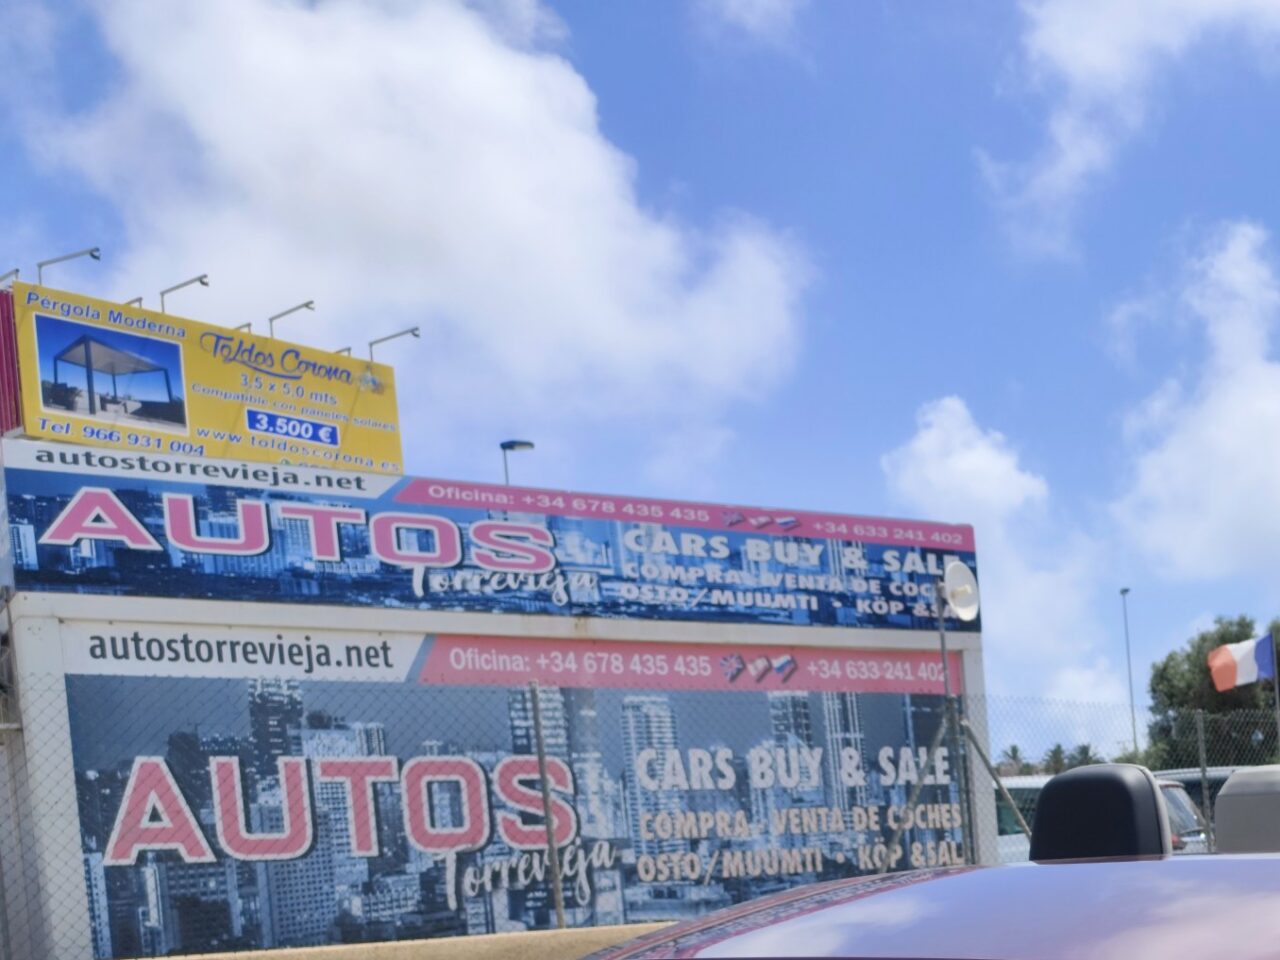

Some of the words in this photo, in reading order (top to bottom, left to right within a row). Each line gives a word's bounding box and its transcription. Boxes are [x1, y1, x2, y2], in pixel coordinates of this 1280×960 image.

[27, 292, 101, 320] Pérgola
[108, 309, 186, 337] Moderna
[200, 332, 275, 369] Toldos
[281, 349, 353, 384] Corona
[192, 383, 269, 406] Compatible
[272, 400, 297, 412] con
[352, 416, 396, 432] solares
[310, 390, 337, 405] mts
[83, 426, 121, 443] 966
[127, 433, 162, 449] 931
[169, 441, 205, 457] 004
[256, 413, 313, 439] 3.500
[318, 426, 333, 443] €
[36, 447, 367, 492] autostorrevieja.net
[428, 484, 515, 505] Oficina:
[522, 493, 566, 509] +34
[572, 498, 615, 514] 678
[622, 503, 664, 518] 435
[670, 507, 710, 523] 435
[38, 486, 556, 574] AUTOS
[623, 528, 730, 559] CARS
[746, 538, 824, 566] BUY
[842, 547, 868, 570] &
[813, 521, 848, 535] +34
[853, 525, 888, 538] 633
[893, 528, 925, 542] 241
[931, 531, 963, 545] 402
[624, 562, 743, 584] COMPRA
[768, 572, 844, 593] VENTA
[850, 578, 882, 595] DE
[857, 596, 904, 615] KÖP
[89, 630, 393, 674] autostorrevieja.net
[450, 648, 531, 672] Oficina:
[536, 651, 578, 673] +34
[583, 652, 624, 674] 678
[629, 654, 669, 675] 435
[674, 656, 712, 676] 435
[807, 659, 842, 679] +34
[845, 660, 880, 680] 633
[884, 661, 914, 681] 241
[918, 662, 947, 682] 402
[636, 747, 736, 790] CARS
[749, 746, 824, 789] BUY
[841, 746, 866, 786] &
[878, 746, 951, 785] SALE
[103, 754, 579, 866] AUTOS
[639, 809, 751, 840] COMPRA
[773, 806, 845, 835] VENTA
[852, 805, 880, 831] DE
[887, 803, 962, 831] COCHES
[432, 837, 617, 911] Torreveja
